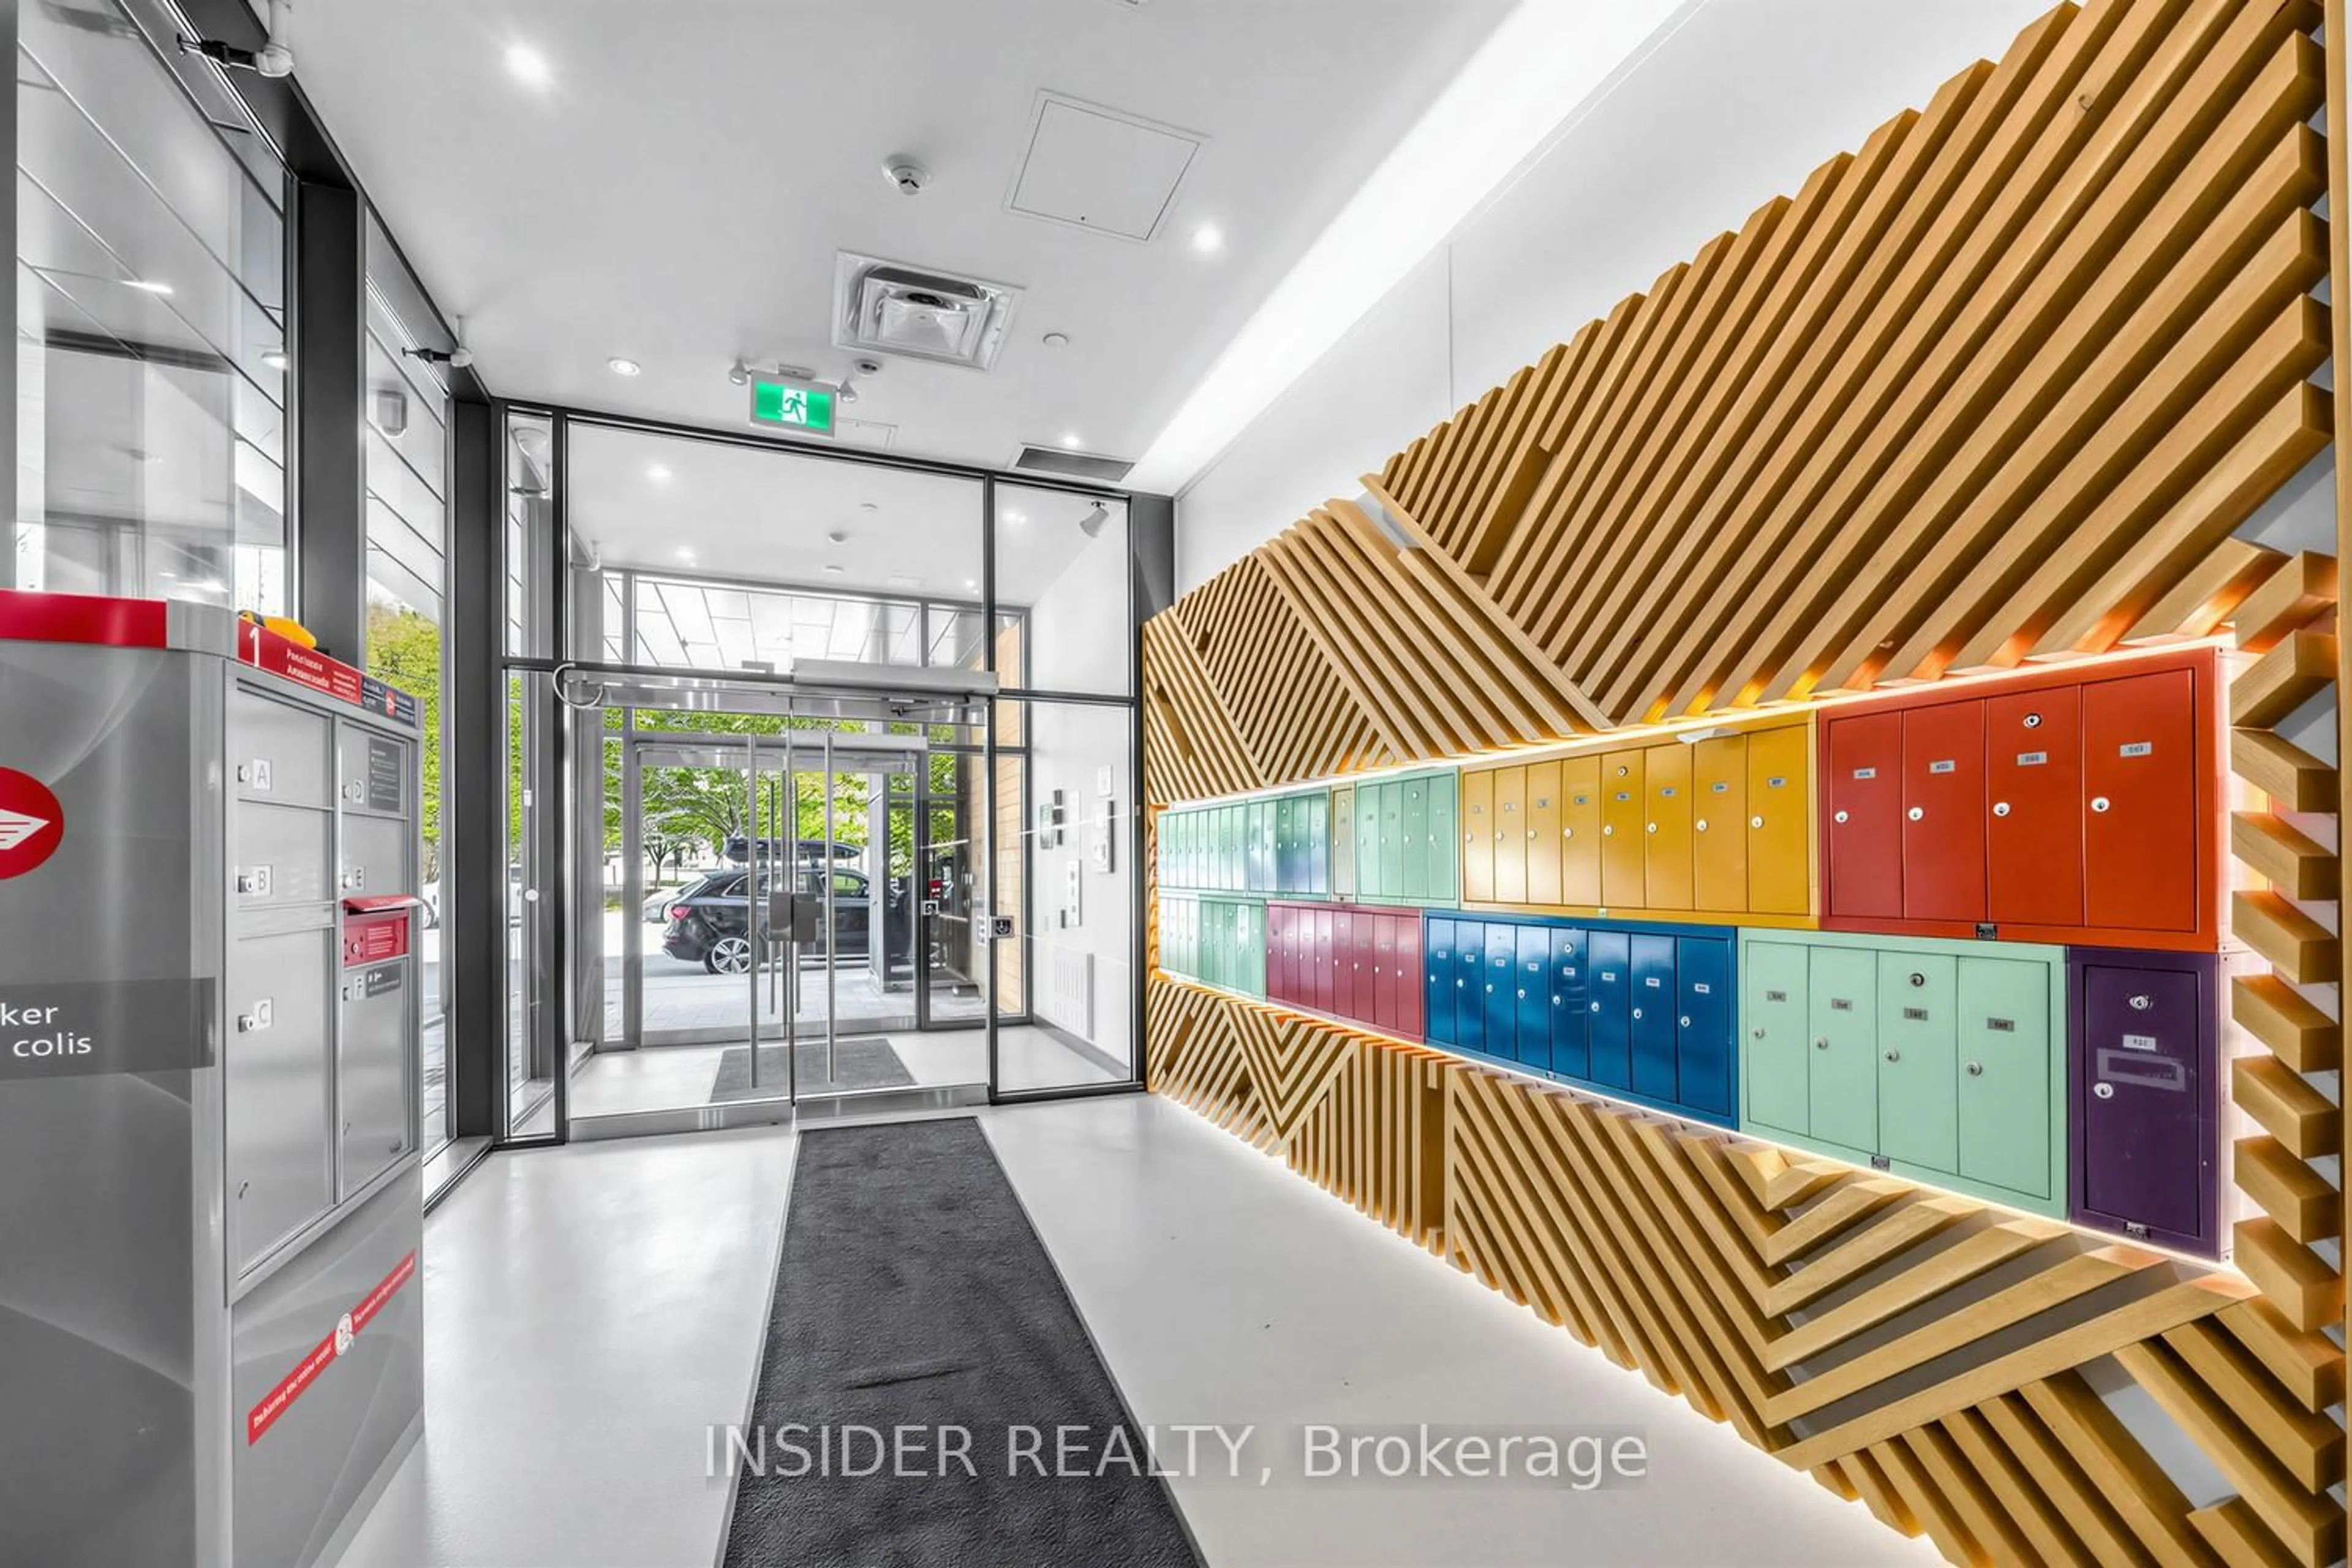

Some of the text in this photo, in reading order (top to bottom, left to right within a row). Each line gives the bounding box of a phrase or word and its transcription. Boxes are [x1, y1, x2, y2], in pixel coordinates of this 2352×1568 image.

[249, 627, 260, 668] 1
[257, 764, 267, 788] A
[258, 870, 266, 891] B
[1, 1002, 59, 1026] ker
[259, 1003, 268, 1023] C
[13, 1031, 92, 1057] colis
